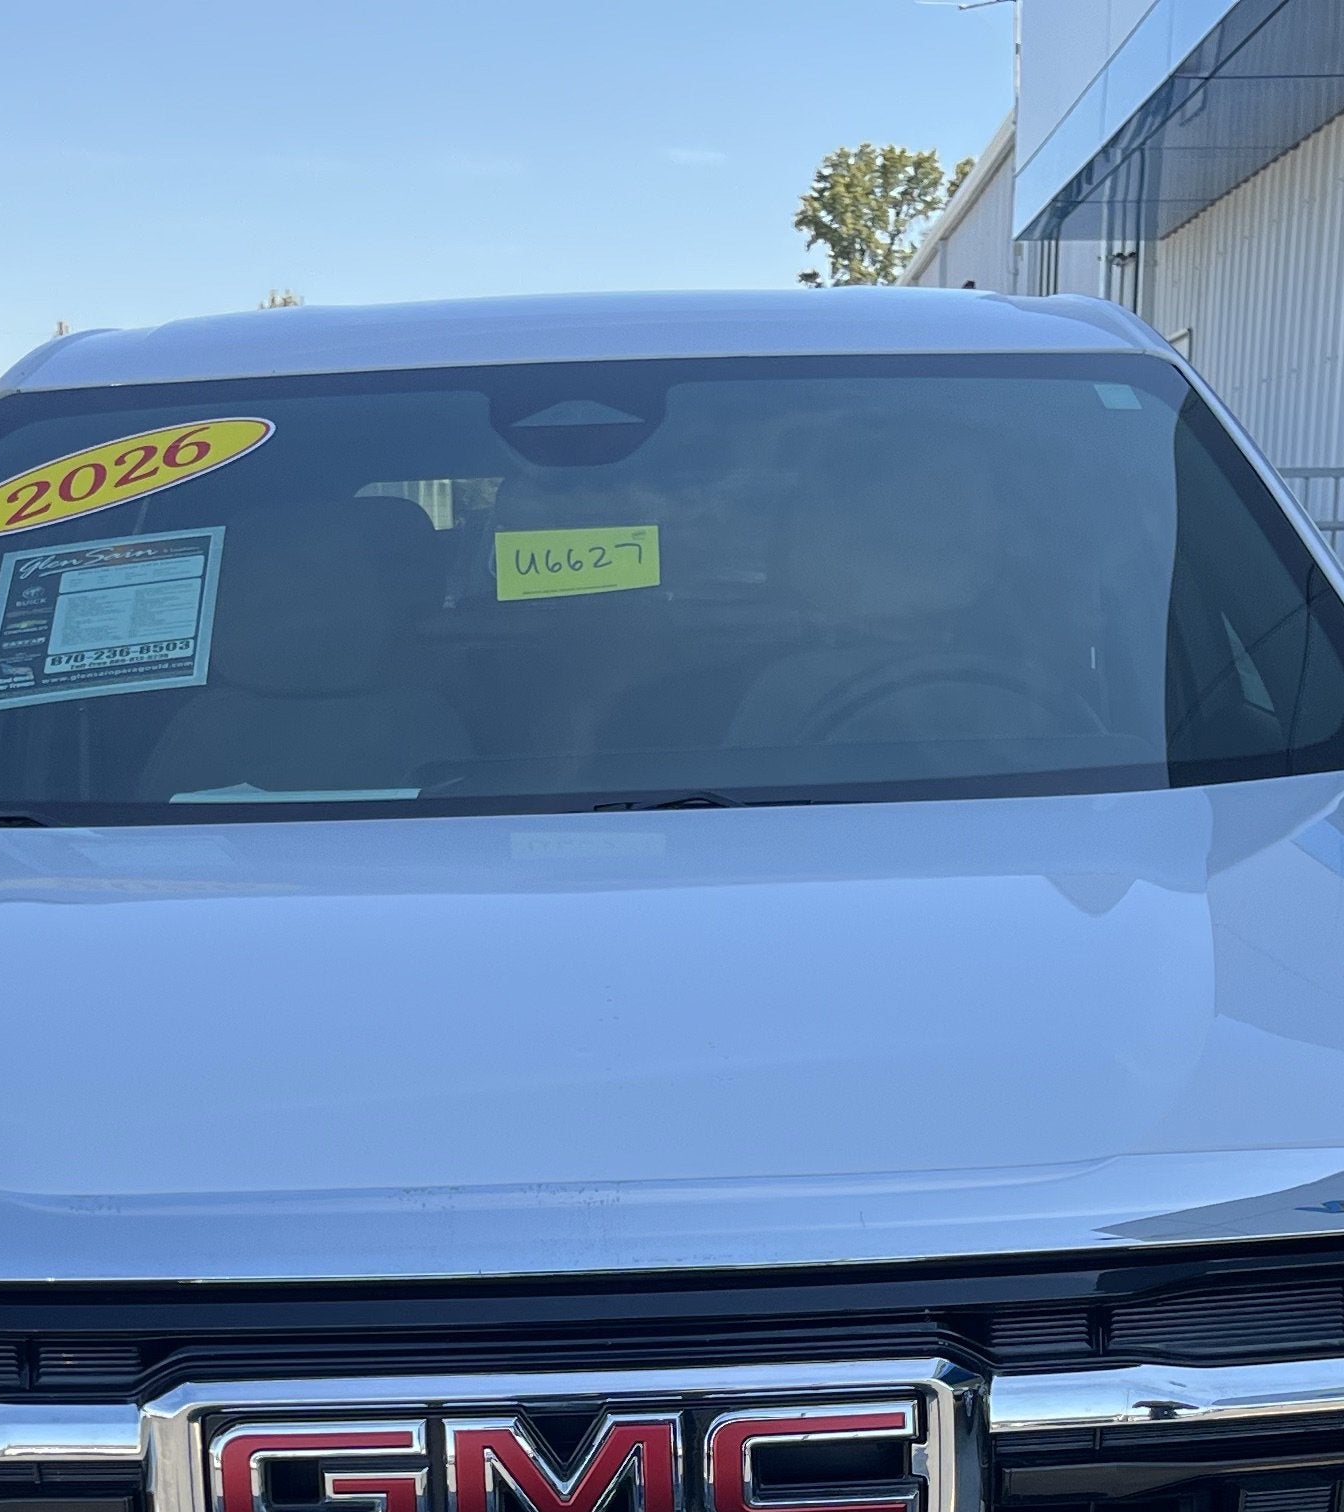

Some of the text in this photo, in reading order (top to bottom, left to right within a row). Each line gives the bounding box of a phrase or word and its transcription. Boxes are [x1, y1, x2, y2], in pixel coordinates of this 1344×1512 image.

[5, 426, 212, 526] 2026
[19, 553, 84, 580] Glen
[85, 547, 158, 566] Sain
[49, 639, 192, 667] 870-236-8503
